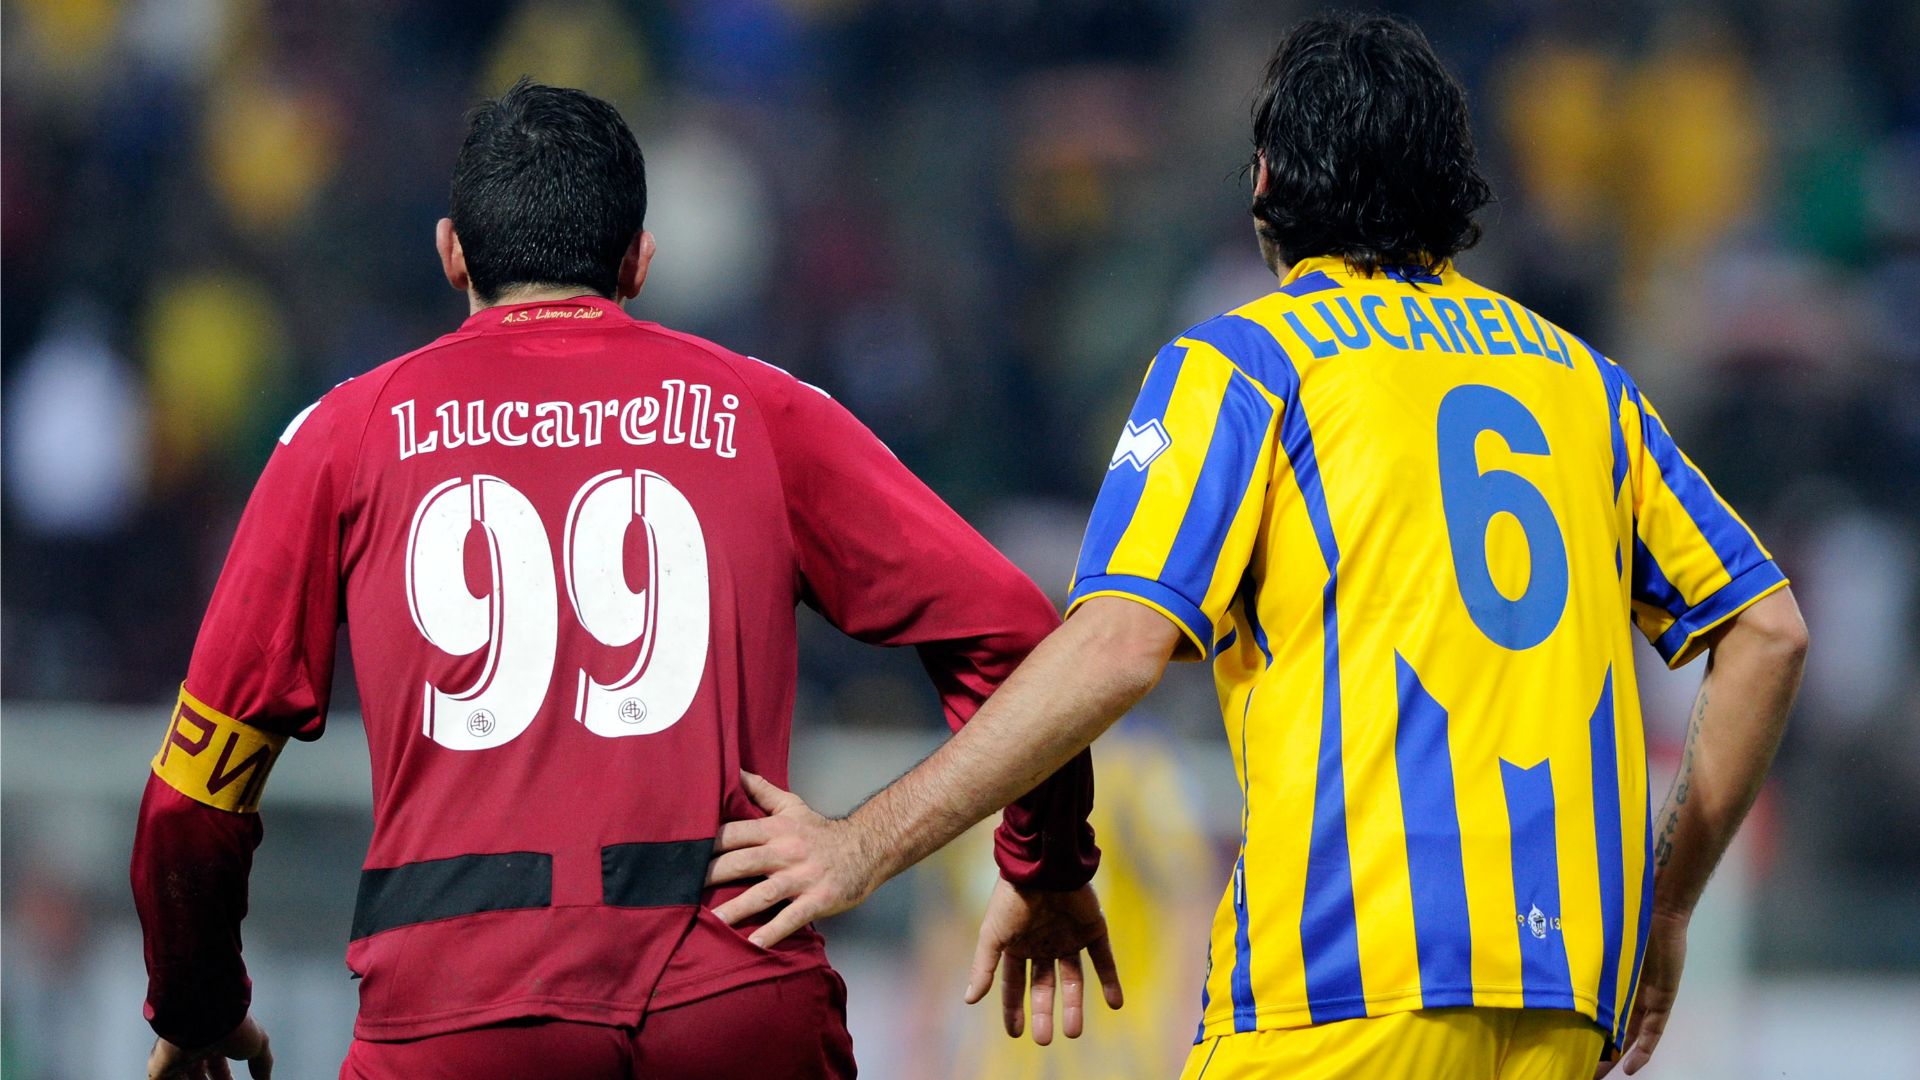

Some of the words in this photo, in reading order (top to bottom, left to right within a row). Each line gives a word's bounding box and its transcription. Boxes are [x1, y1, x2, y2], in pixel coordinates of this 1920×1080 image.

[502, 311, 532, 324] A.S.
[573, 306, 604, 319] Calcio
[1282, 294, 1575, 370] LUCARELLI
[391, 379, 739, 460] Lucarelli
[1437, 384, 1570, 651] 6
[405, 468, 711, 751] 99
